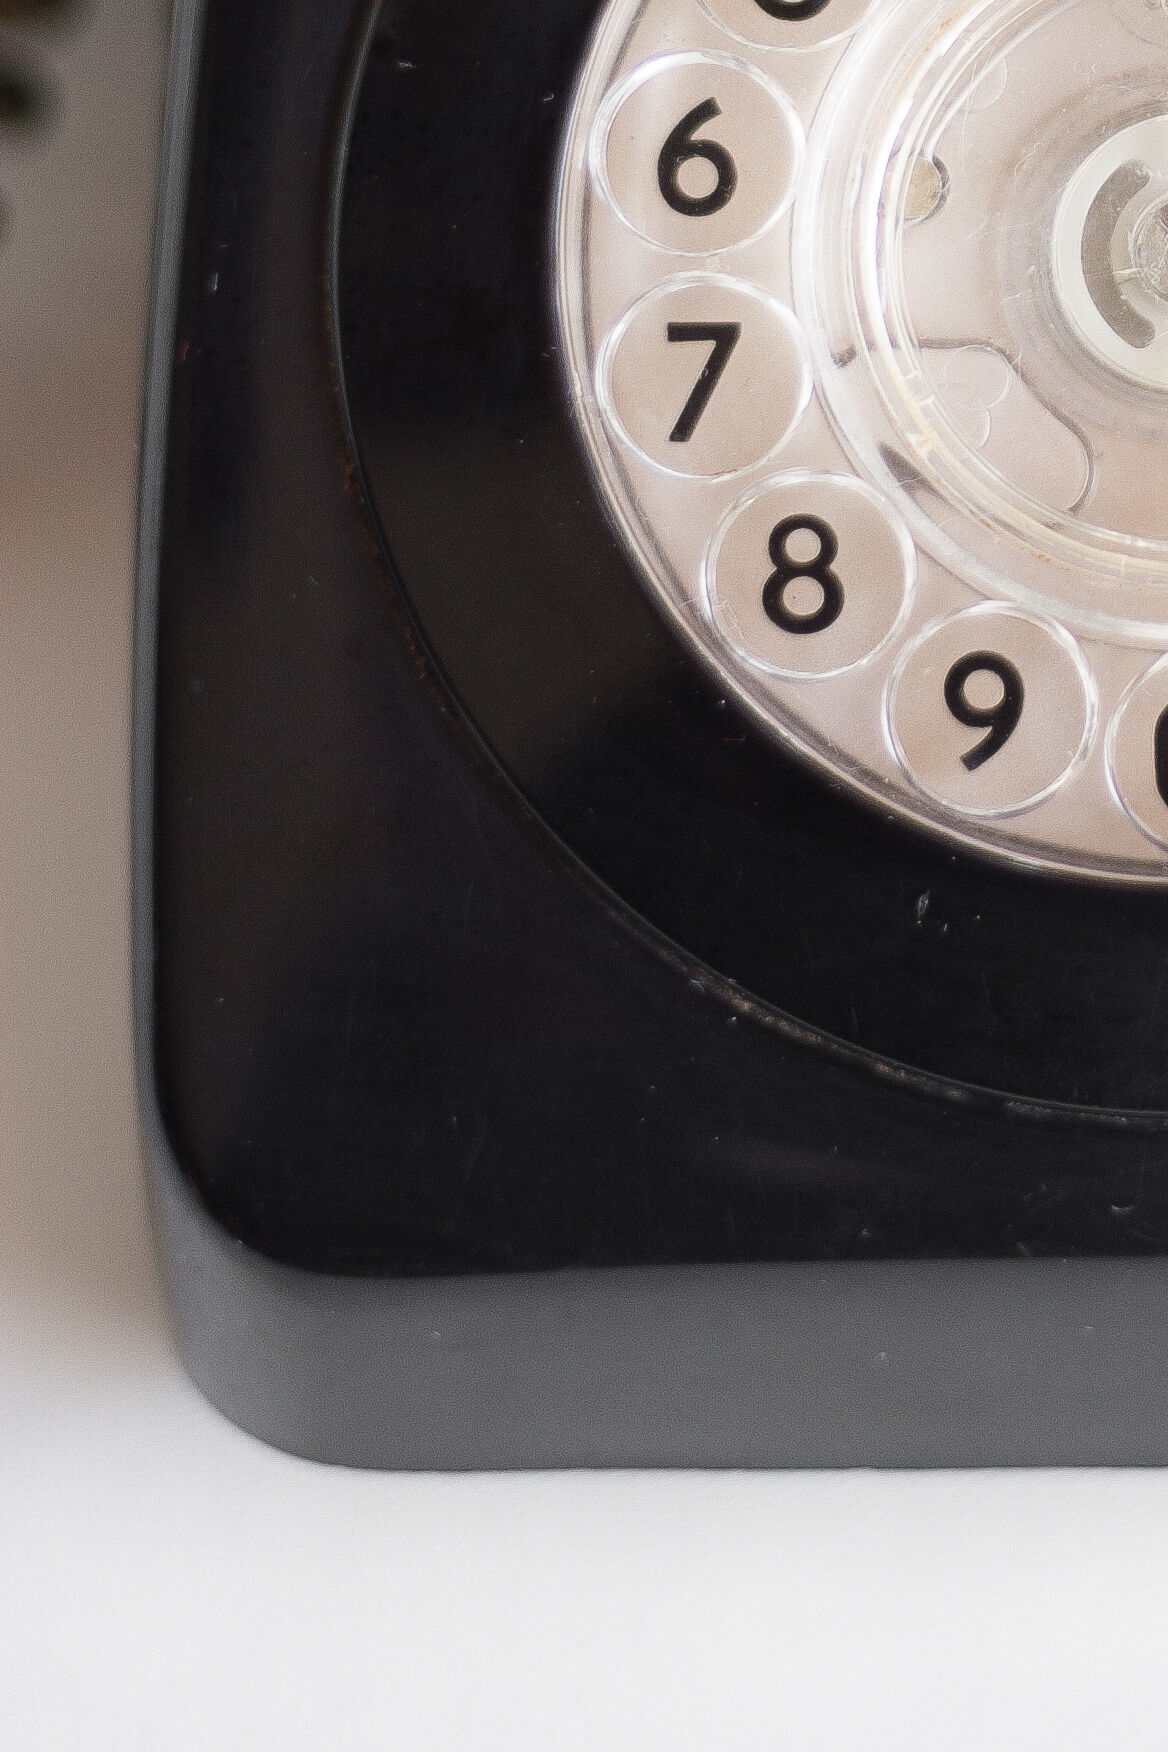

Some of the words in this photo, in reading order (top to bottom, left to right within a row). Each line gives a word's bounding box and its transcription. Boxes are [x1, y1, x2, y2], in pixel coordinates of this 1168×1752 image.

[657, 97, 737, 217] 6
[666, 321, 740, 443] 7
[761, 514, 845, 635] 8
[943, 650, 1025, 772] 9
